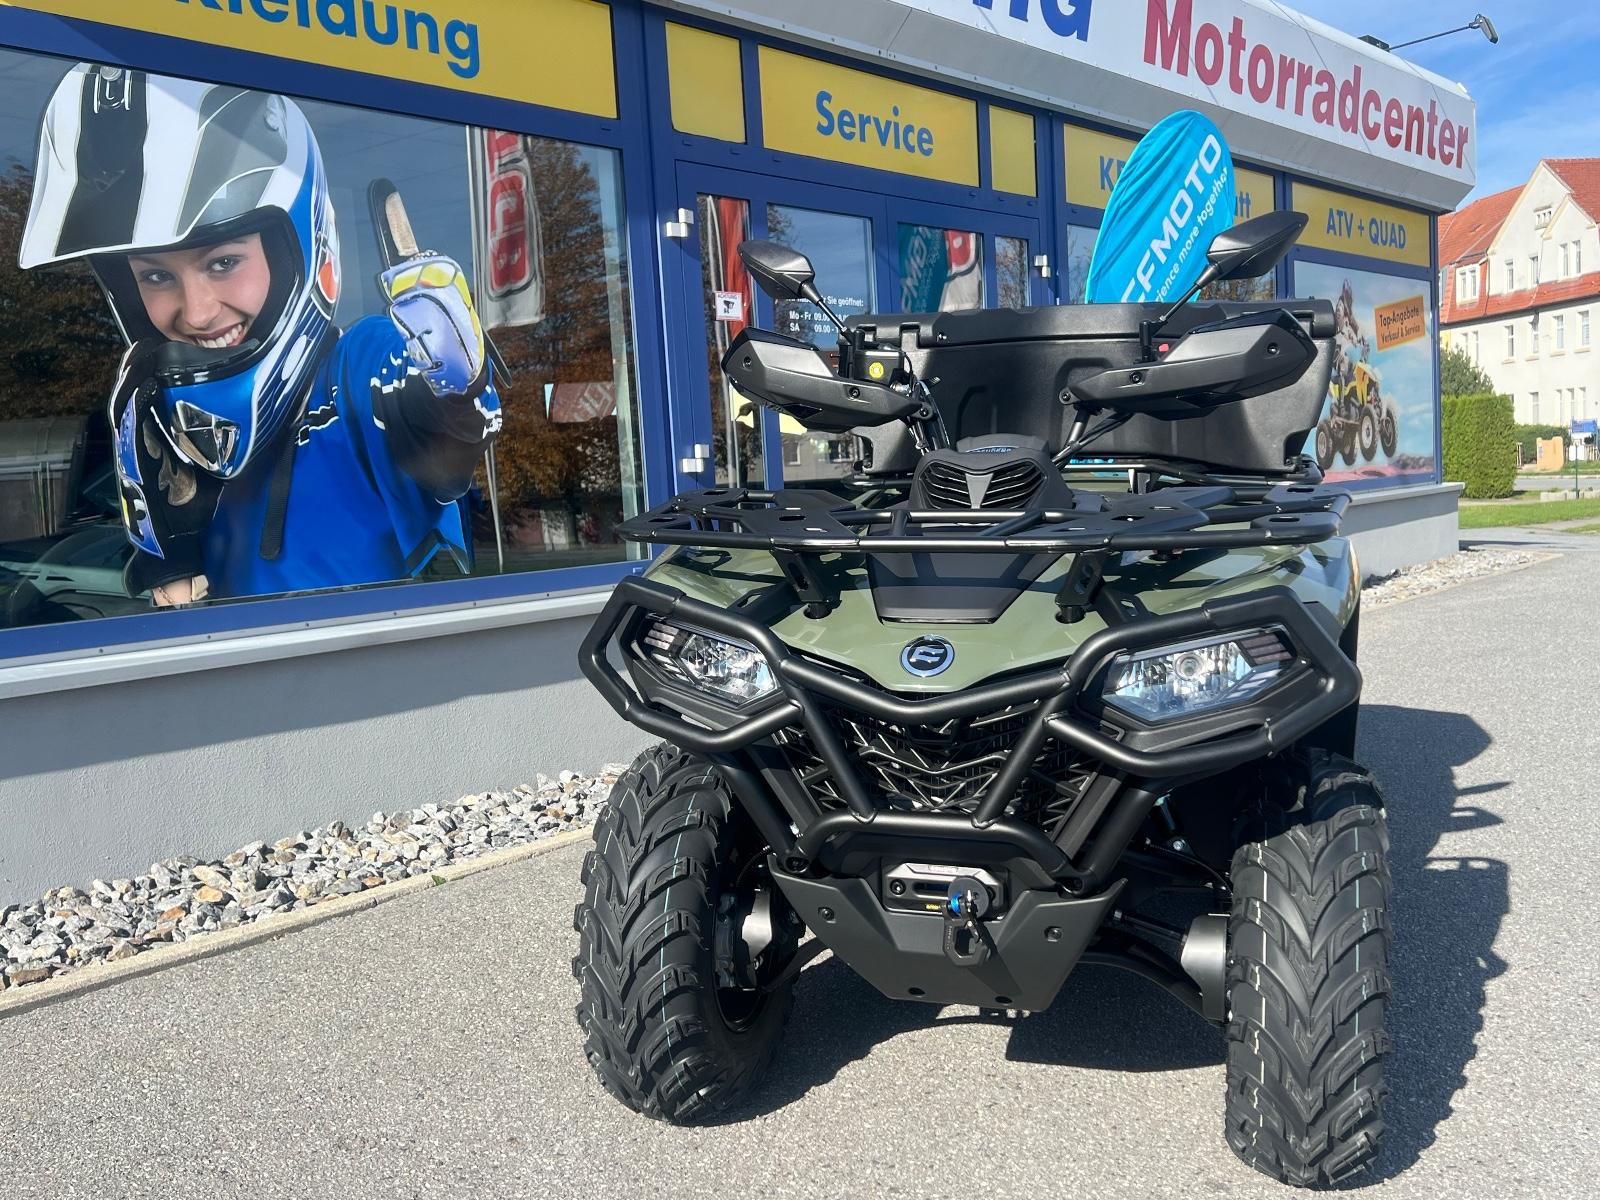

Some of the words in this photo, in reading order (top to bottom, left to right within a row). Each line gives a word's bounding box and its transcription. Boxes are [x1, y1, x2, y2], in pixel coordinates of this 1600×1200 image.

[1143, 0, 1469, 169] Motorradcenter
[816, 90, 934, 157] Service
[1178, 225, 1200, 264] more
[1326, 207, 1354, 239] ATV
[1357, 218, 1365, 238] +
[1368, 217, 1406, 250] QUAD
[789, 322, 800, 332] SA
[1380, 306, 1419, 328] Top-Angebote
